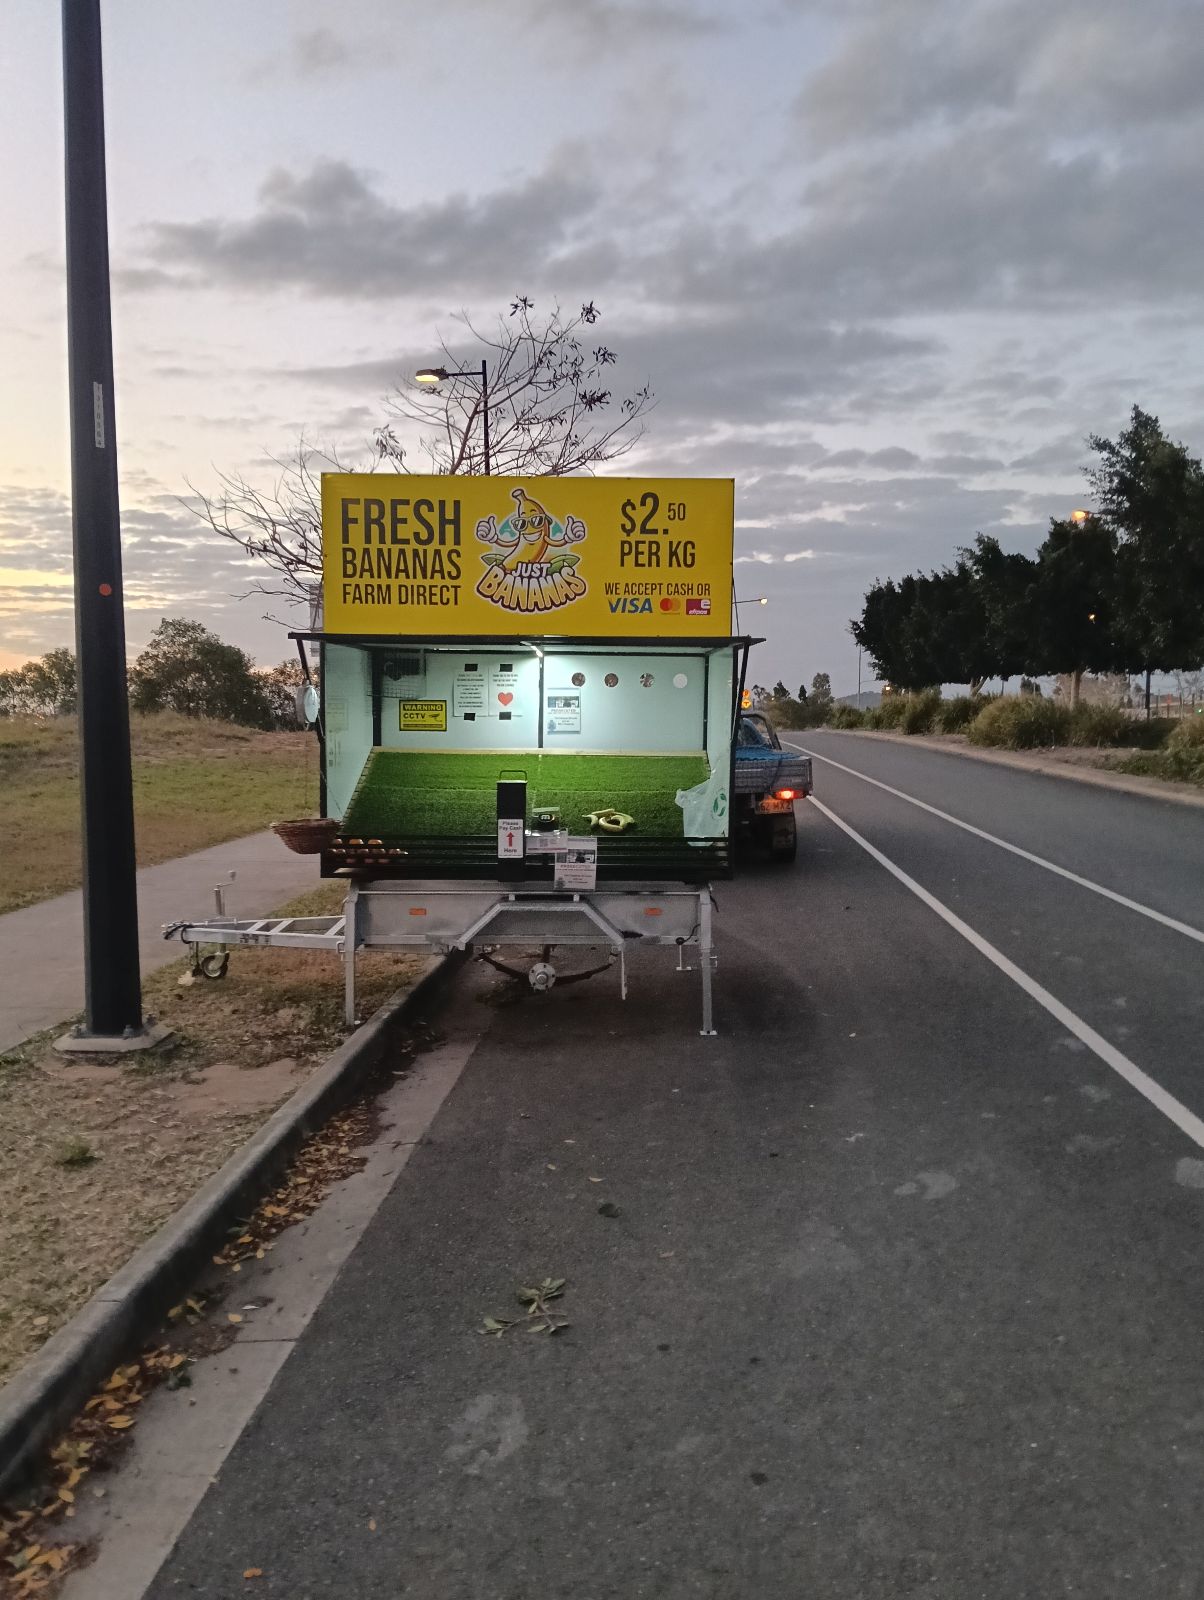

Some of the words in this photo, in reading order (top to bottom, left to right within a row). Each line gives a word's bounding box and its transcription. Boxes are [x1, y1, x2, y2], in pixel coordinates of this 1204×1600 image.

[341, 498, 461, 546] FRESH
[667, 502, 686, 521] 50
[342, 548, 461, 580] BANANAS
[620, 540, 660, 568] PER
[668, 540, 696, 568] KG
[511, 562, 551, 577] JUST
[342, 583, 391, 604] FARM
[398, 584, 461, 606] DIRECT
[477, 564, 586, 612] BANANAS
[605, 582, 621, 596] WE
[623, 582, 663, 596] ACCEPT
[666, 582, 694, 597] CASH
[697, 583, 711, 597] OR
[608, 597, 653, 614] VISA
